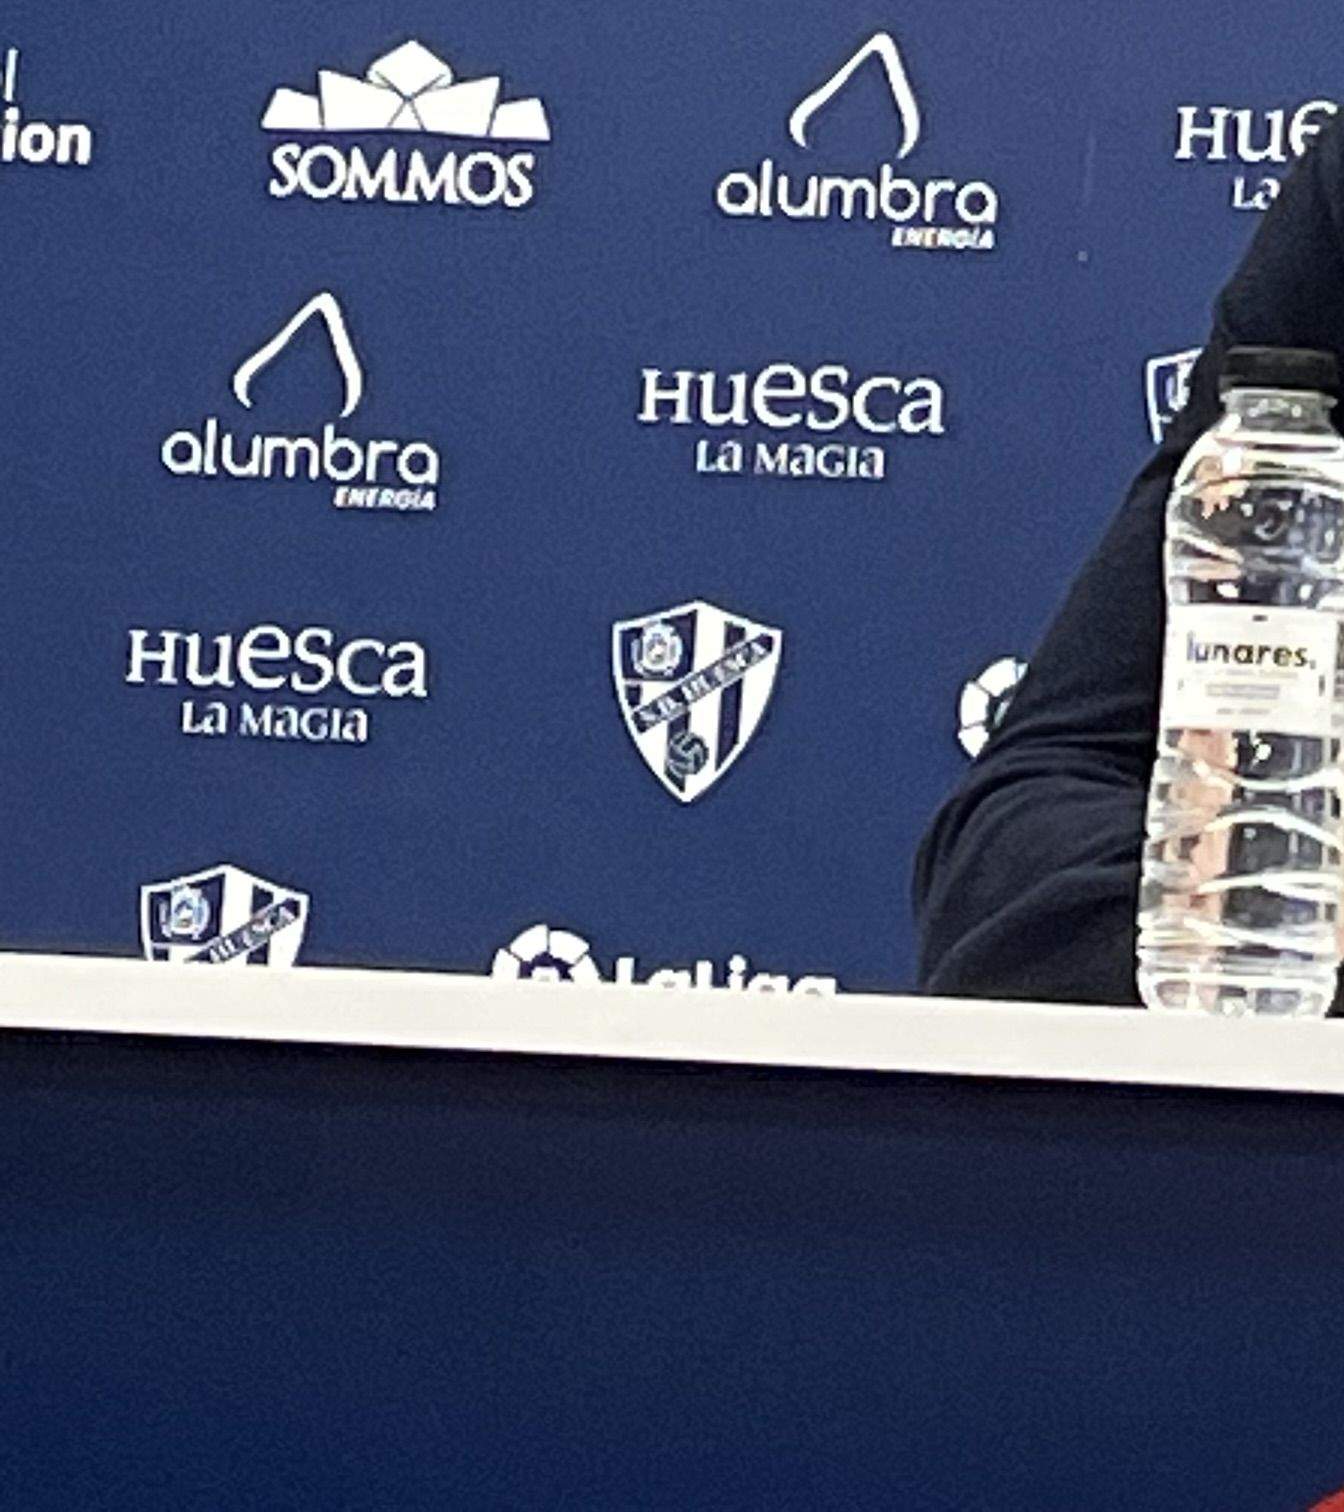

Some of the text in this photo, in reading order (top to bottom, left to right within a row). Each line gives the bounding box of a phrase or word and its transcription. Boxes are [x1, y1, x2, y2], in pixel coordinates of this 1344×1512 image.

[269, 143, 534, 207] SOMMOS
[717, 159, 998, 224] alumbra
[162, 418, 439, 484] alumbra
